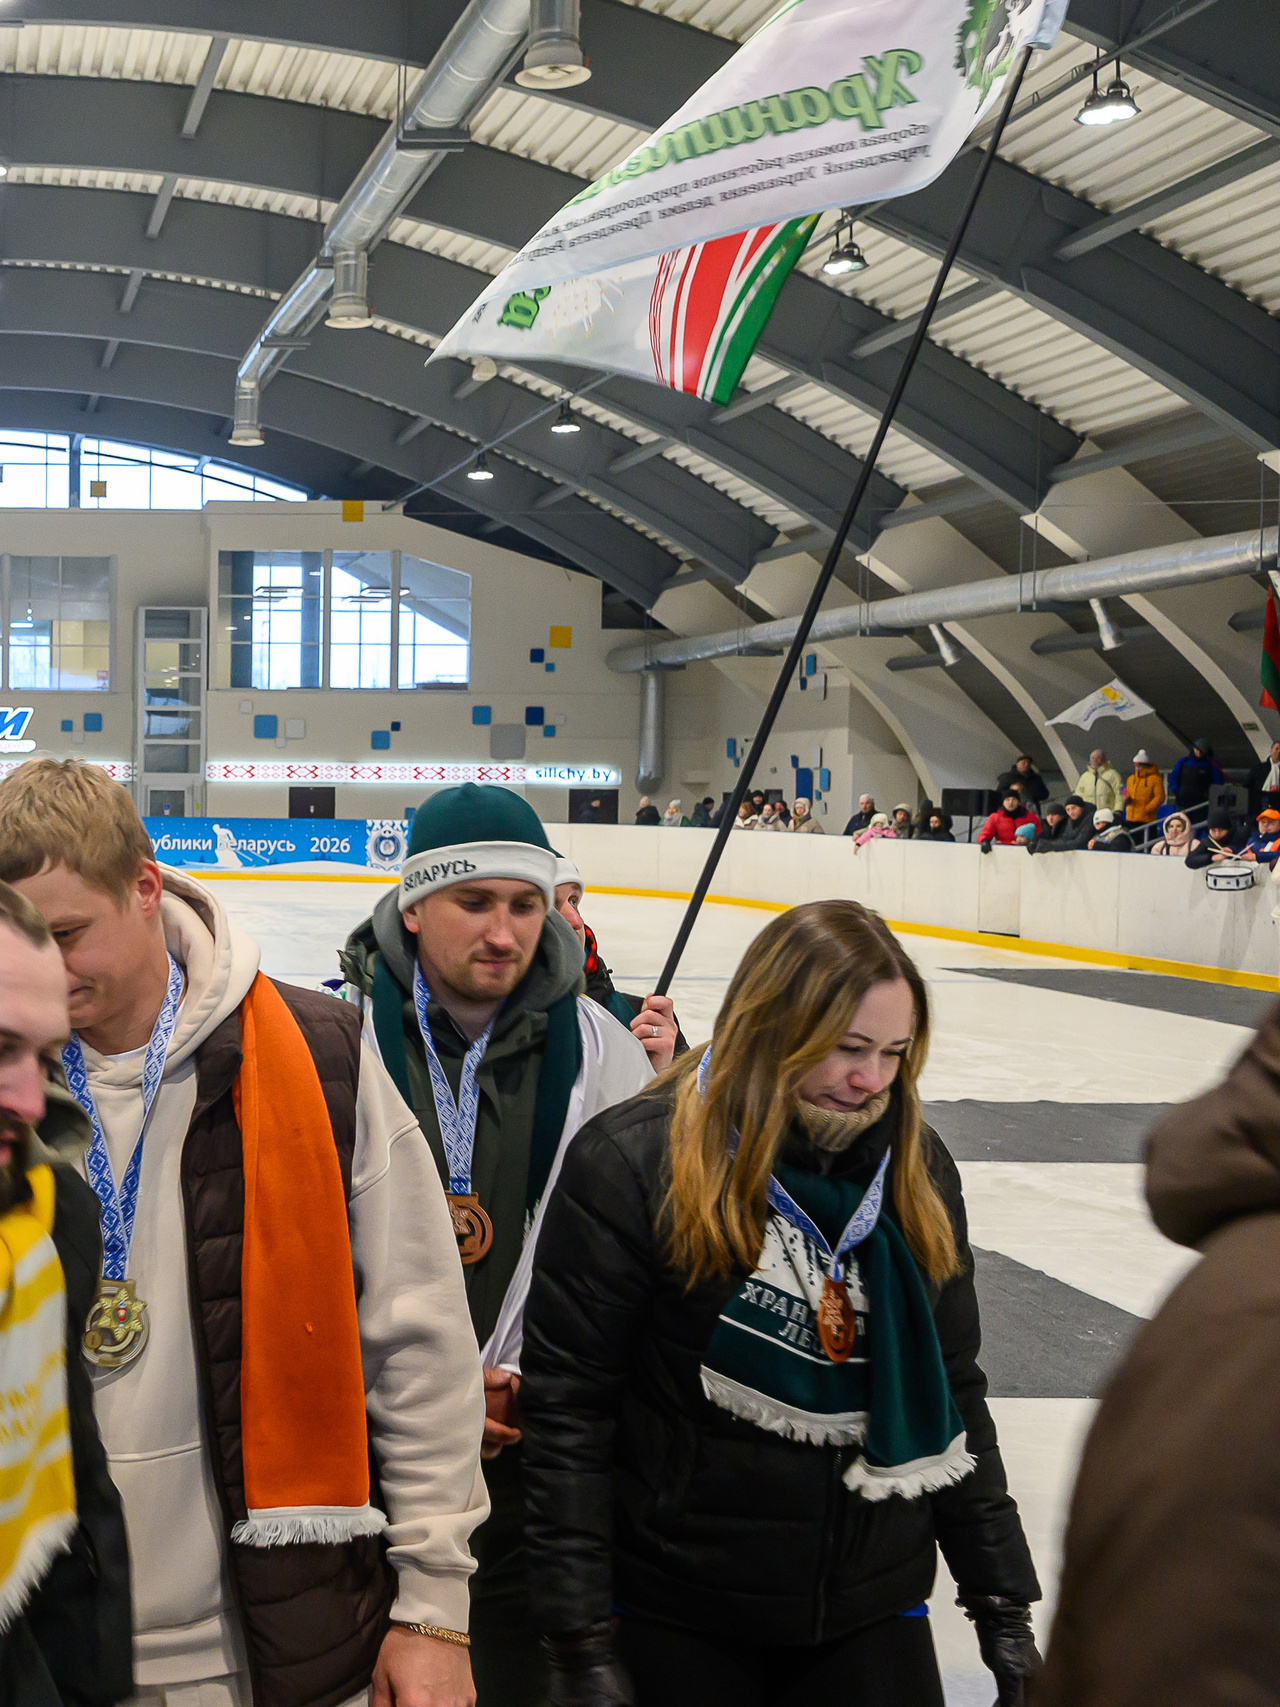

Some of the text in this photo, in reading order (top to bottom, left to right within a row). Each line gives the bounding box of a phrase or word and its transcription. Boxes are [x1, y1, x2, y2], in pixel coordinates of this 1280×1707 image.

[534, 767, 612, 781] silichy.by
[150, 834, 212, 854] ублики
[217, 834, 296, 855] Беларусь
[310, 836, 351, 853] 2026
[404, 859, 477, 892] БЕЛАРУСЬ
